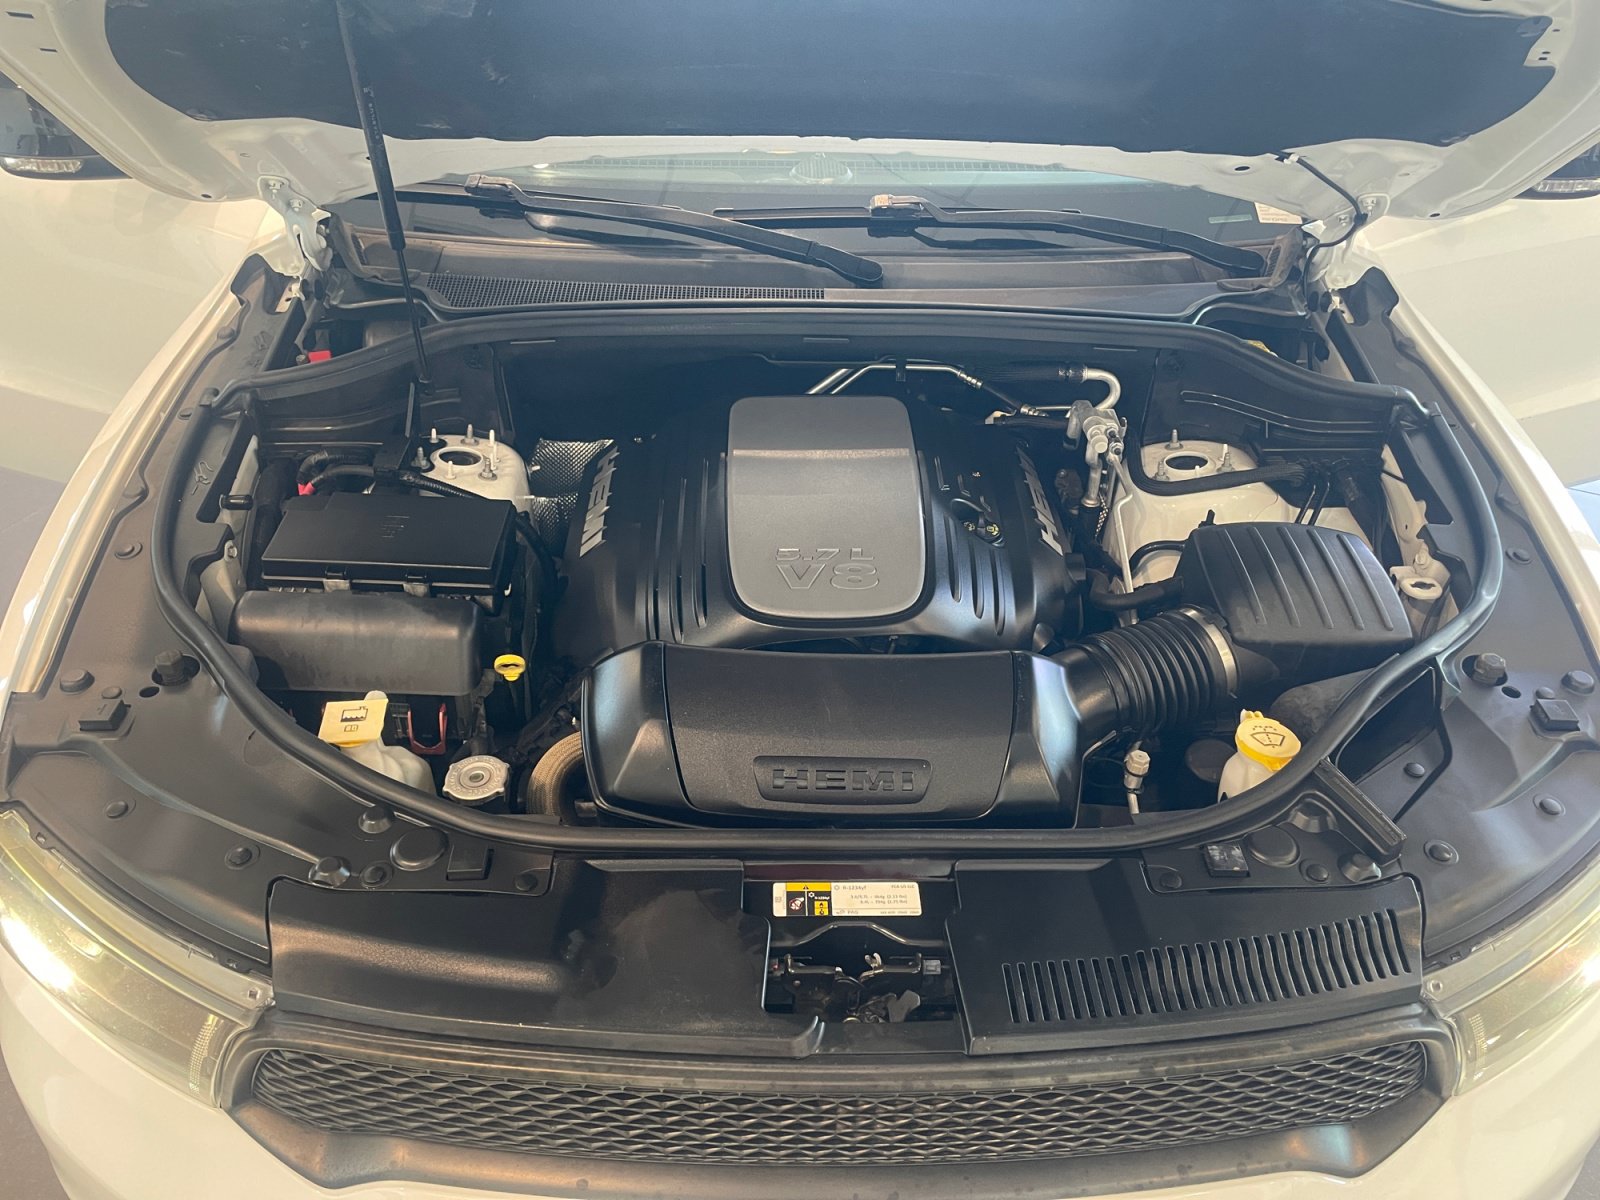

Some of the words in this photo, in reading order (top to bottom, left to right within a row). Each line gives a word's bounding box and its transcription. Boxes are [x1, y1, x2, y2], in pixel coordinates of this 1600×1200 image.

[580, 446, 620, 558] HEMI
[776, 563, 879, 590] V8
[772, 768, 914, 792] HEMI
